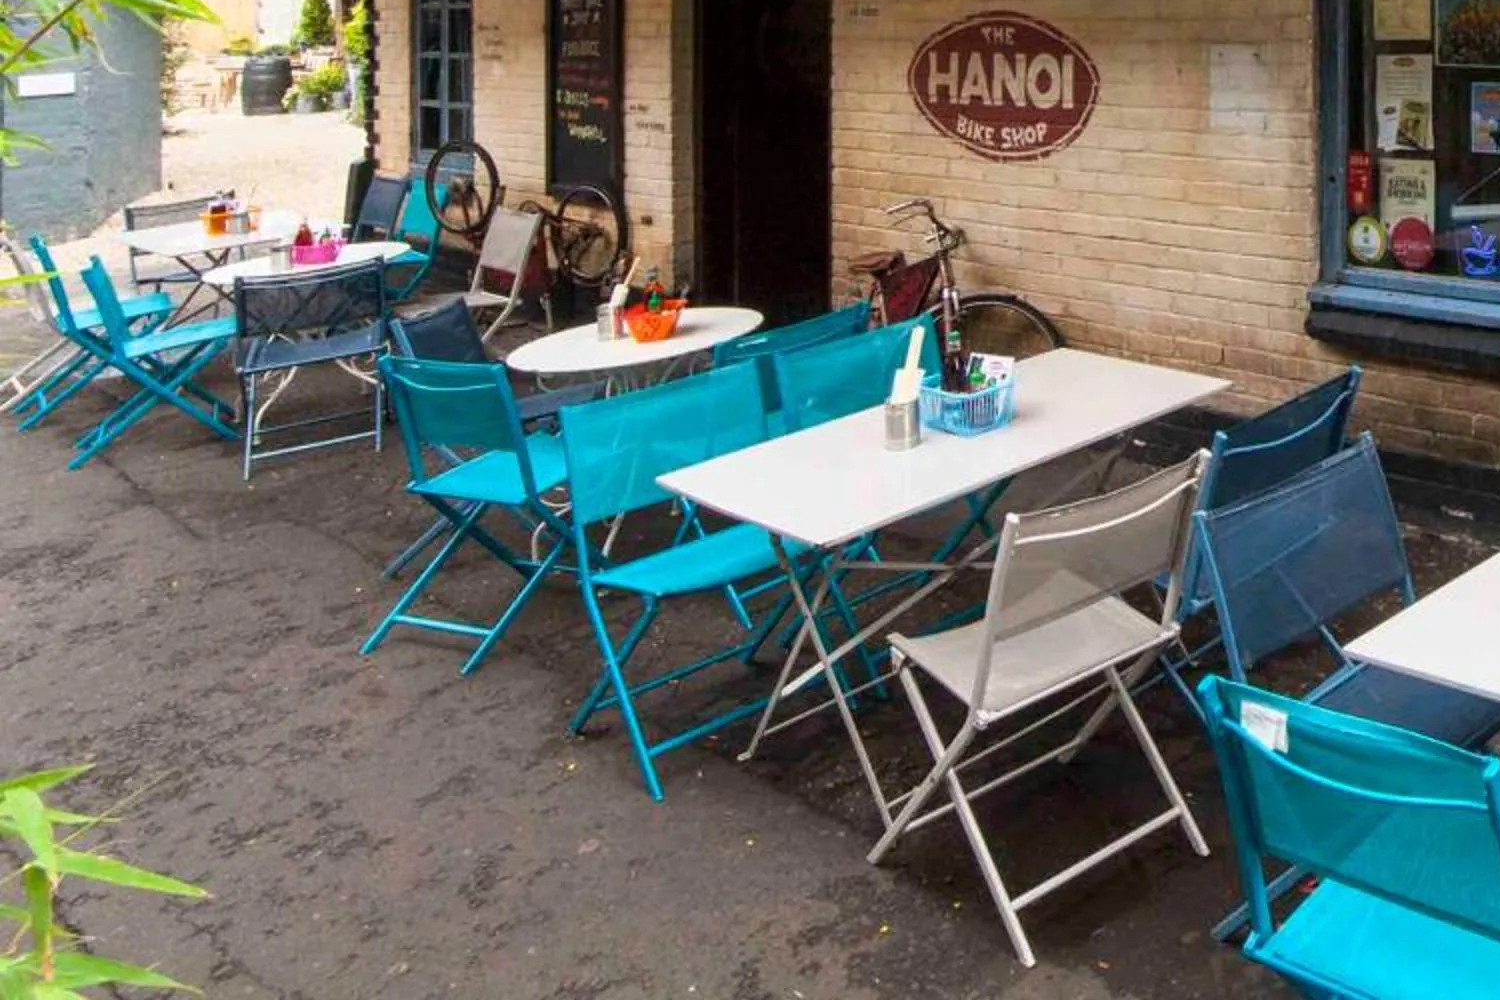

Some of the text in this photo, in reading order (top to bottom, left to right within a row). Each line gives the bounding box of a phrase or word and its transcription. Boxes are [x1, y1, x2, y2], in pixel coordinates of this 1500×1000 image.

[979, 26, 1017, 46] THE
[927, 50, 1075, 110] HANOI
[956, 114, 1048, 149] BIKE SHOP
